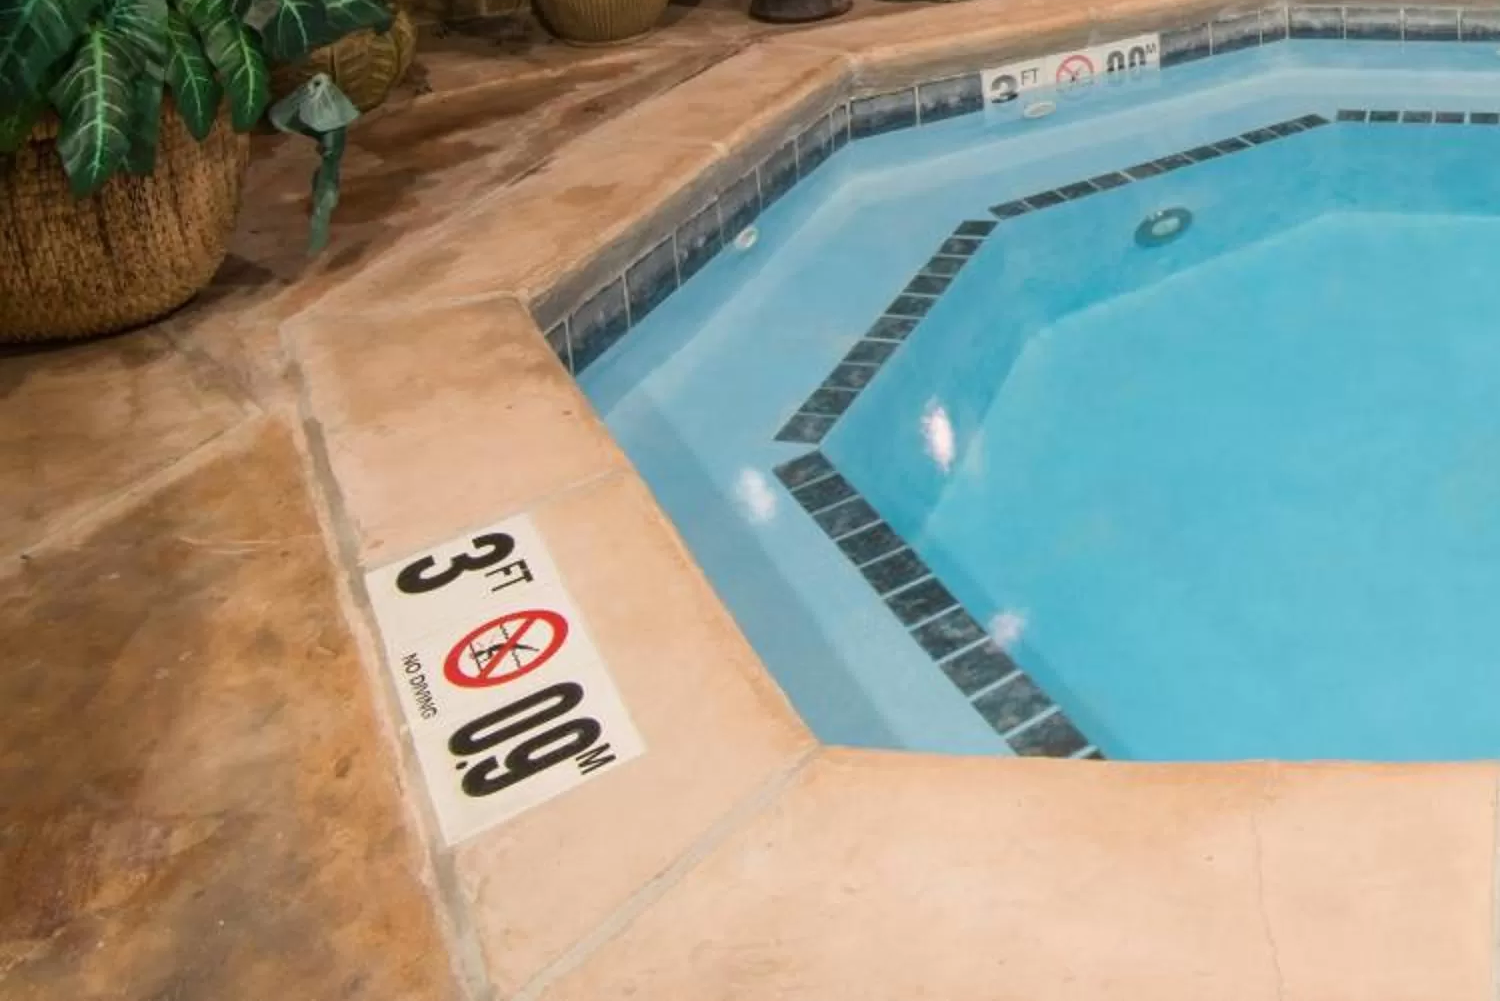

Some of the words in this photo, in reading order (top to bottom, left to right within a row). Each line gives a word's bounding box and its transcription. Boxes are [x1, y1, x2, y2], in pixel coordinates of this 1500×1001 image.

[1021, 67, 1040, 86] FT
[395, 532, 515, 594] 3
[484, 558, 534, 592] FT
[402, 652, 422, 674] NO
[409, 674, 438, 720] DIVING
[447, 681, 602, 798] 0.9
[575, 742, 616, 776] M
